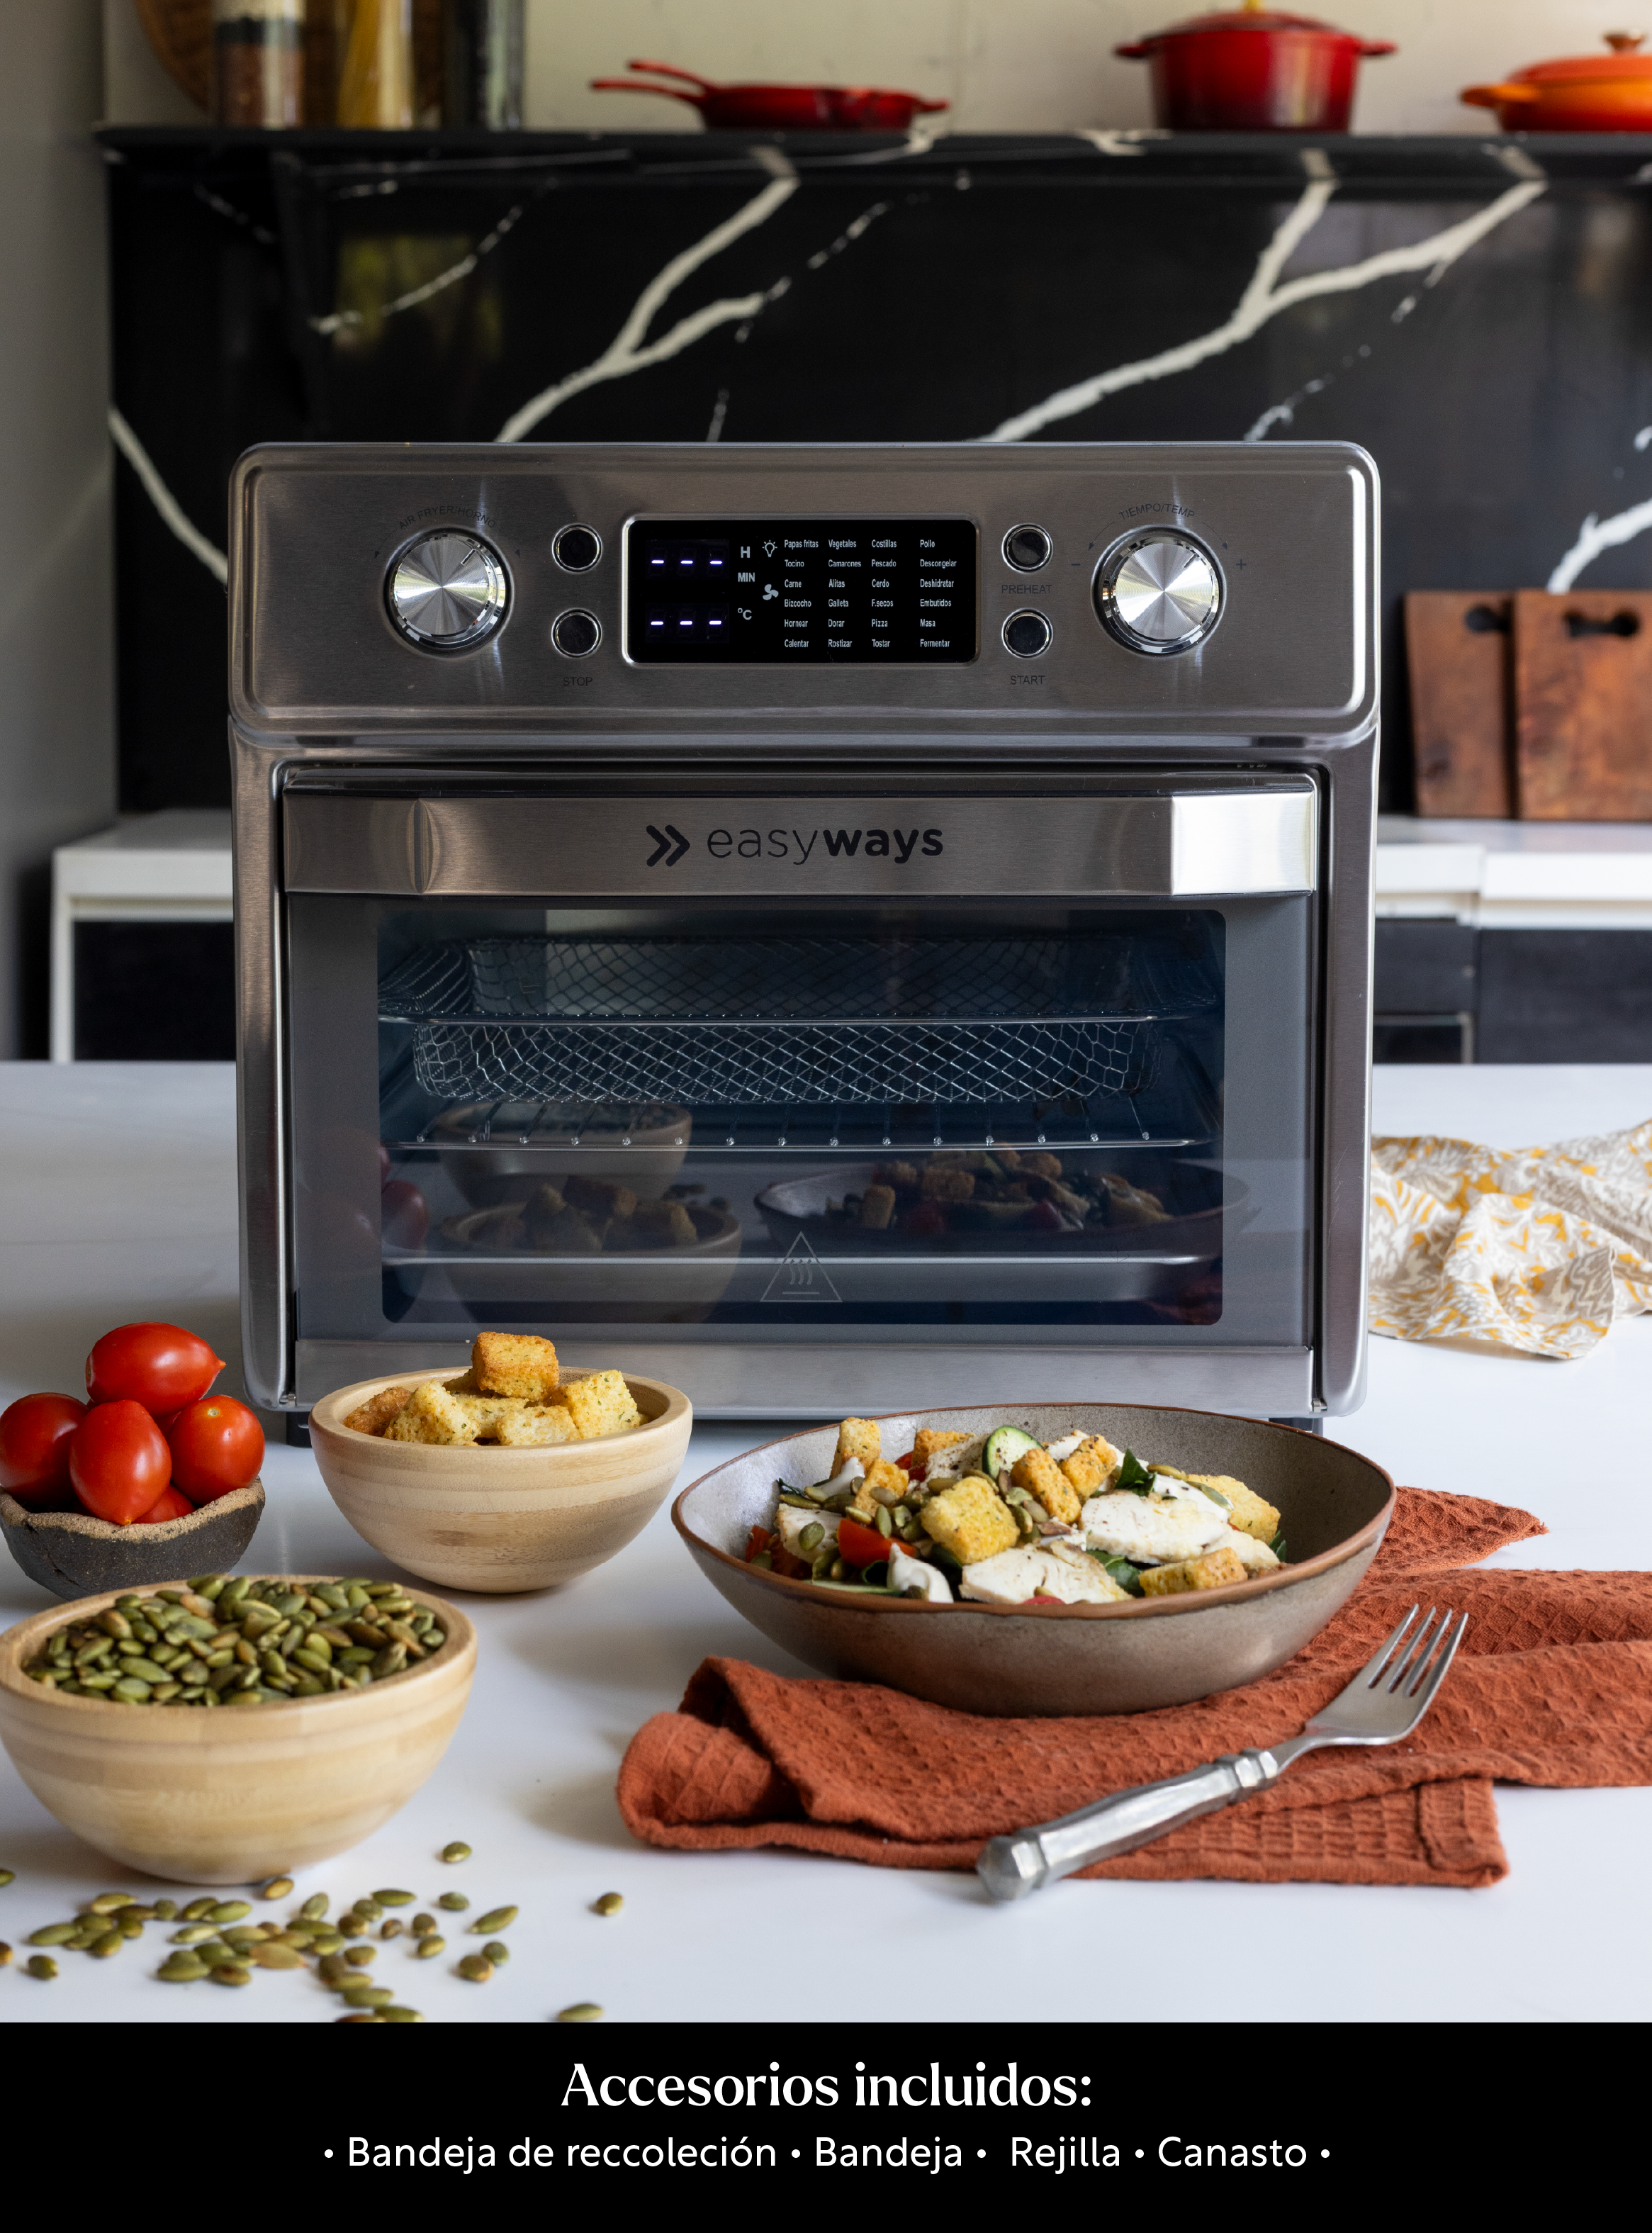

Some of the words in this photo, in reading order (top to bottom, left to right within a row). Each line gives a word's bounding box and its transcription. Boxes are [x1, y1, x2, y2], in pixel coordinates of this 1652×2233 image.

[1118, 503, 1195, 520] TIEMPO/TEMP
[399, 515, 416, 530] AIR
[417, 506, 496, 527] FRYER/HORNO
[785, 539, 802, 549] Papas
[828, 539, 856, 549] Vegetales
[741, 547, 750, 558] H
[785, 559, 804, 567] Tocino
[828, 559, 861, 567] Camarones
[872, 559, 897, 567] Pescado
[921, 559, 957, 569] Descongelar
[738, 573, 755, 583] MIN
[1001, 584, 1052, 595] PREHEAT
[738, 608, 752, 620] °C
[785, 619, 808, 627] Hornear
[828, 619, 845, 627] Dorar
[563, 676, 592, 687] STOP
[1010, 675, 1045, 685] START
[707, 829, 943, 865] easyways
